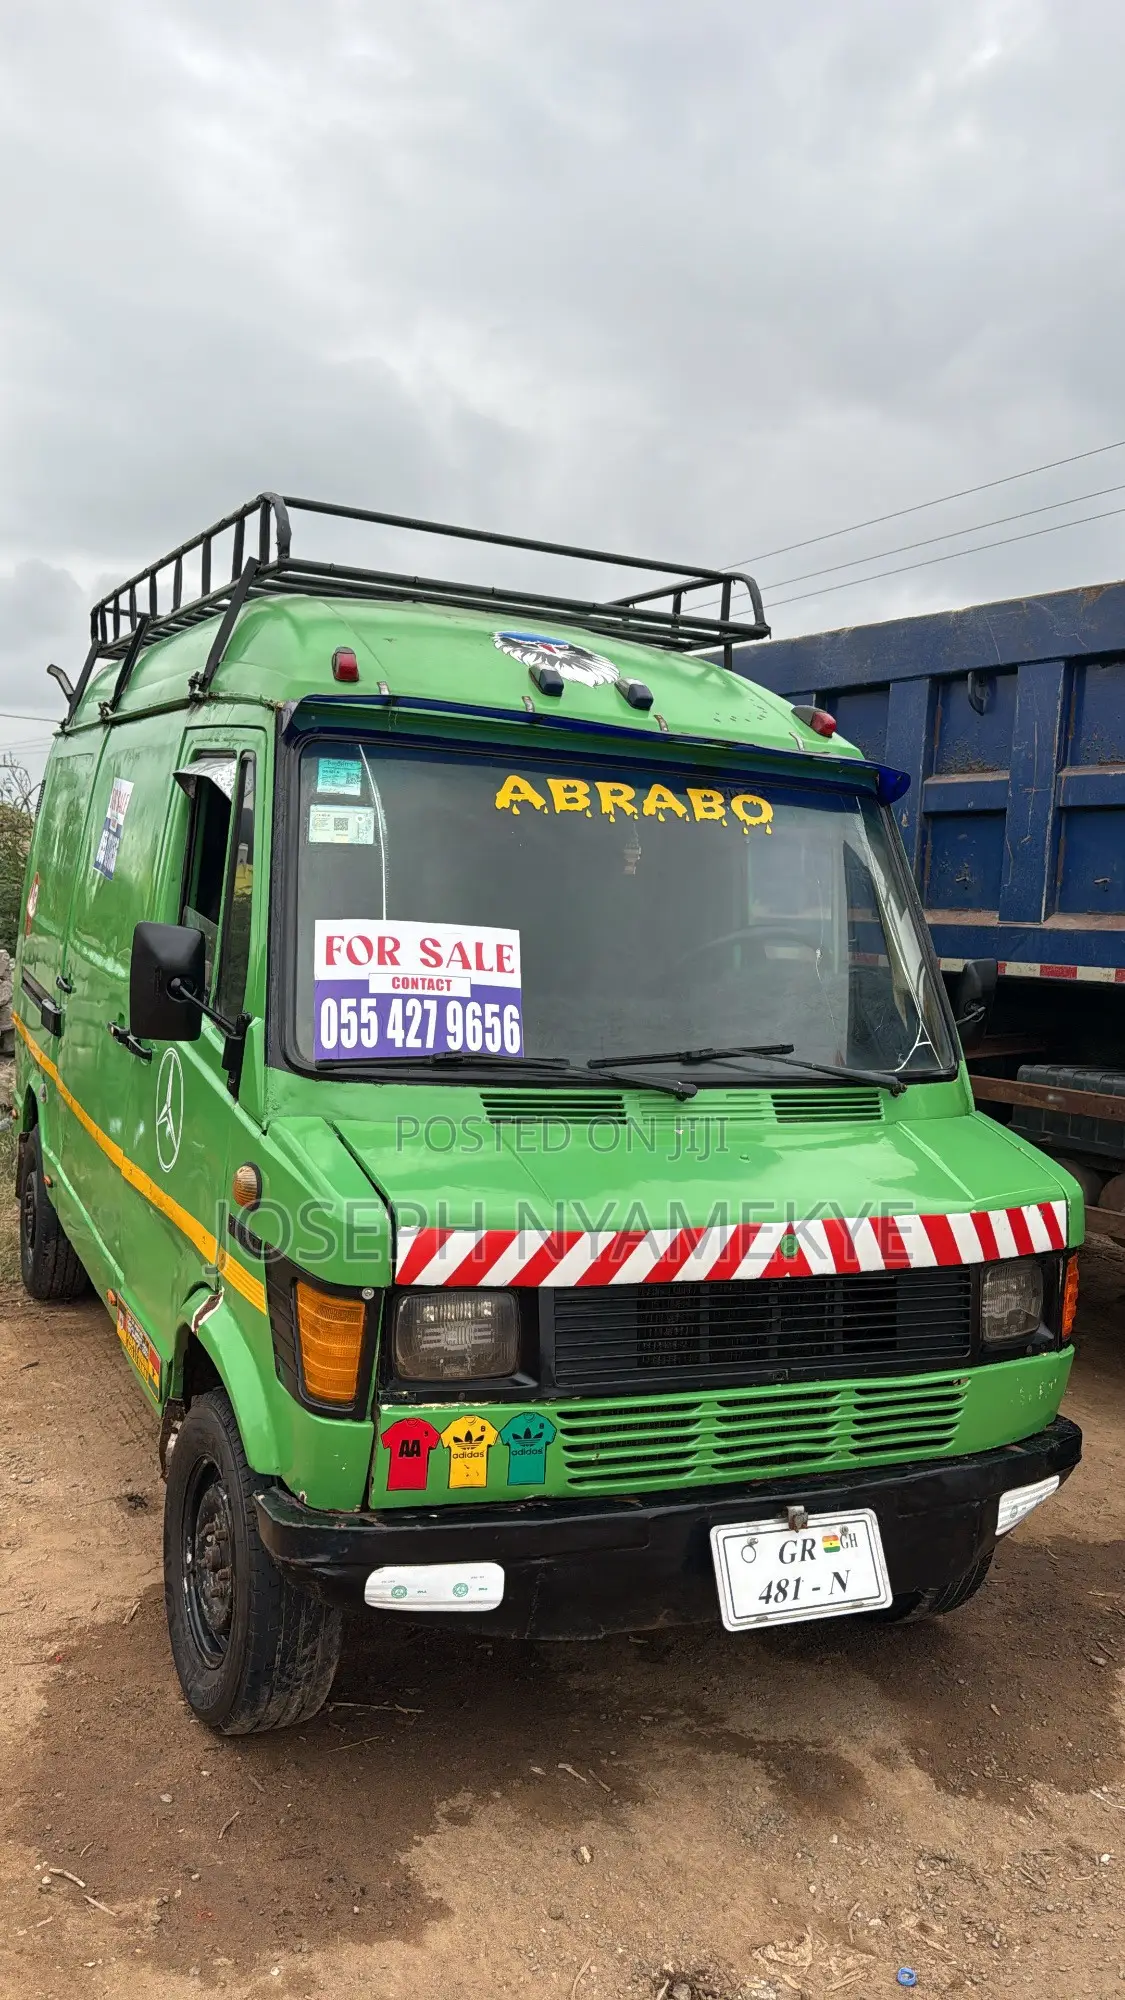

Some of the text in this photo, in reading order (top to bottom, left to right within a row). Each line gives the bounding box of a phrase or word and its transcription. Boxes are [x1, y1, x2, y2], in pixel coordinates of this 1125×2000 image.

[495, 775, 774, 834] ABRABO
[325, 934, 515, 974] FOR SALE
[391, 976, 453, 992] CONTACT
[320, 997, 521, 1054] 055 427 9656
[398, 1439, 421, 1458] AA
[452, 1450, 485, 1460] adidas
[511, 1447, 544, 1456] adidas
[778, 1537, 817, 1565] GR
[839, 1532, 858, 1549] GH
[758, 1575, 802, 1605] 481
[827, 1569, 851, 1596] N
